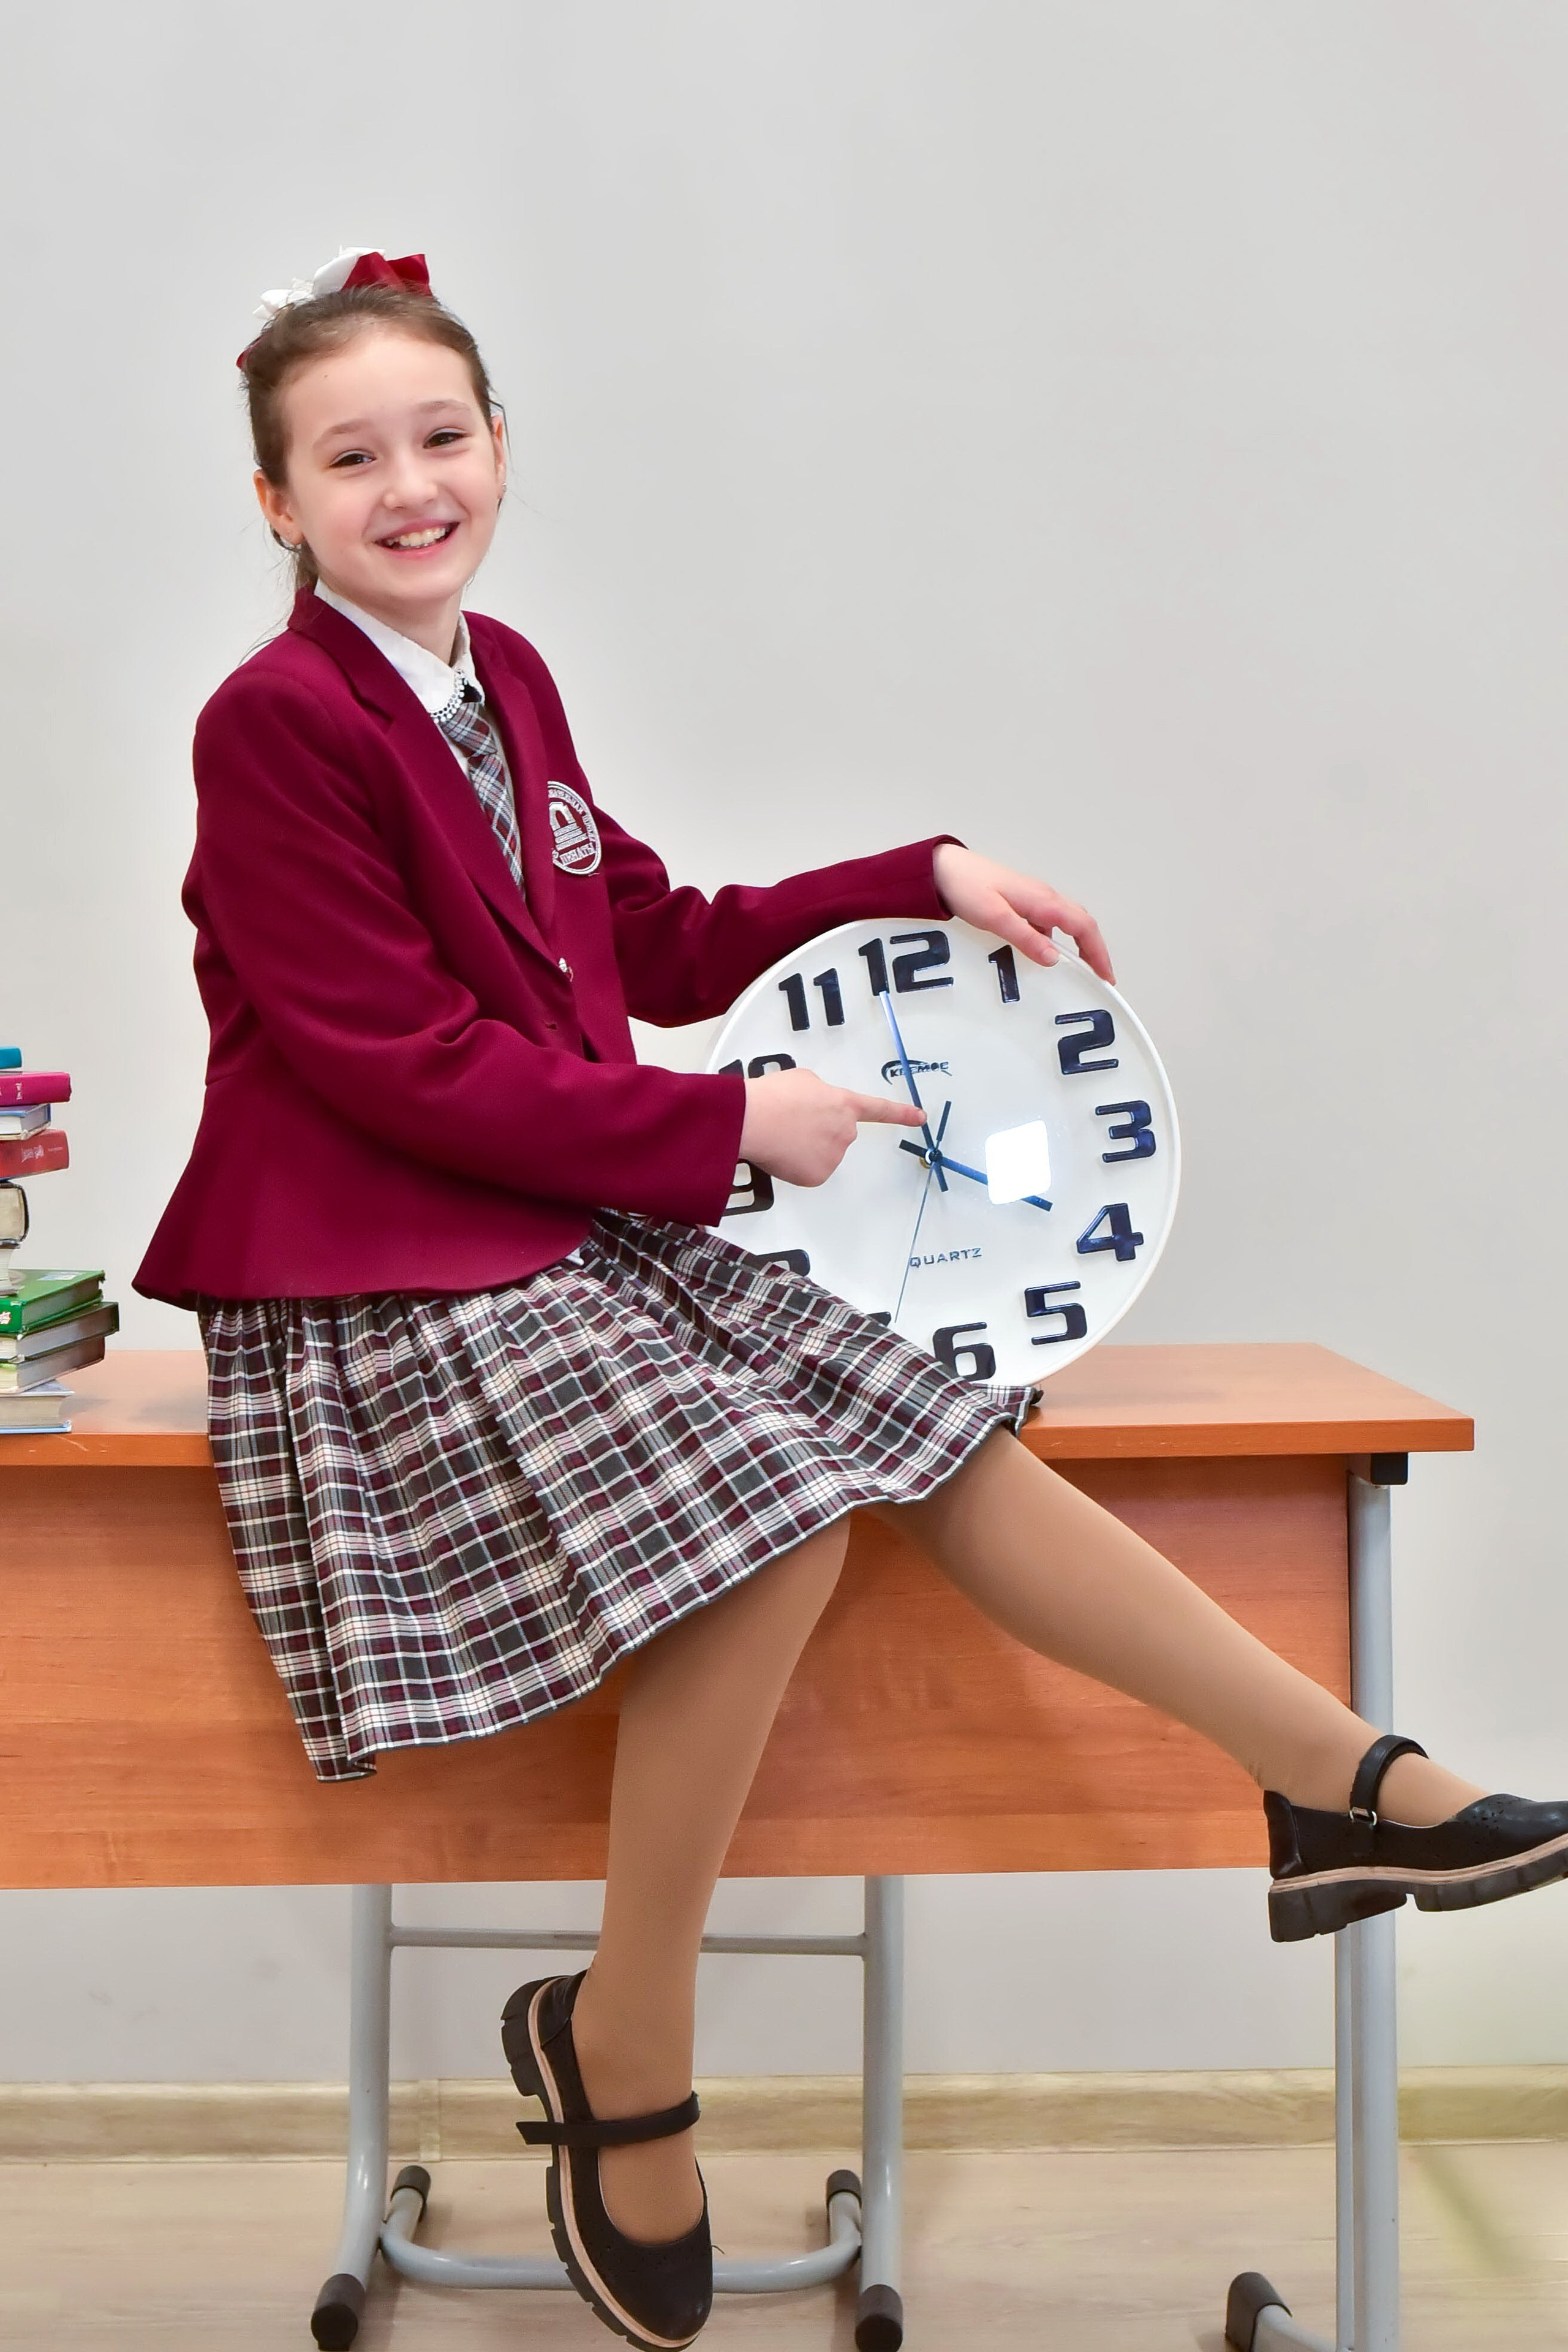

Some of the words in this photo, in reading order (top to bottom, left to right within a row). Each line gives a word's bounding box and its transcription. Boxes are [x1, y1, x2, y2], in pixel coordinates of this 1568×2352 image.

[859, 930, 954, 996] 12
[988, 944, 1020, 1003] 1
[778, 968, 845, 1031] 11
[1055, 1009, 1118, 1075] 2
[1095, 1100, 1156, 1163] 3
[910, 1247, 982, 1268] QUARTZ
[1076, 1203, 1144, 1262] 4
[1024, 1281, 1088, 1346] 5
[933, 1322, 996, 1382] 6
